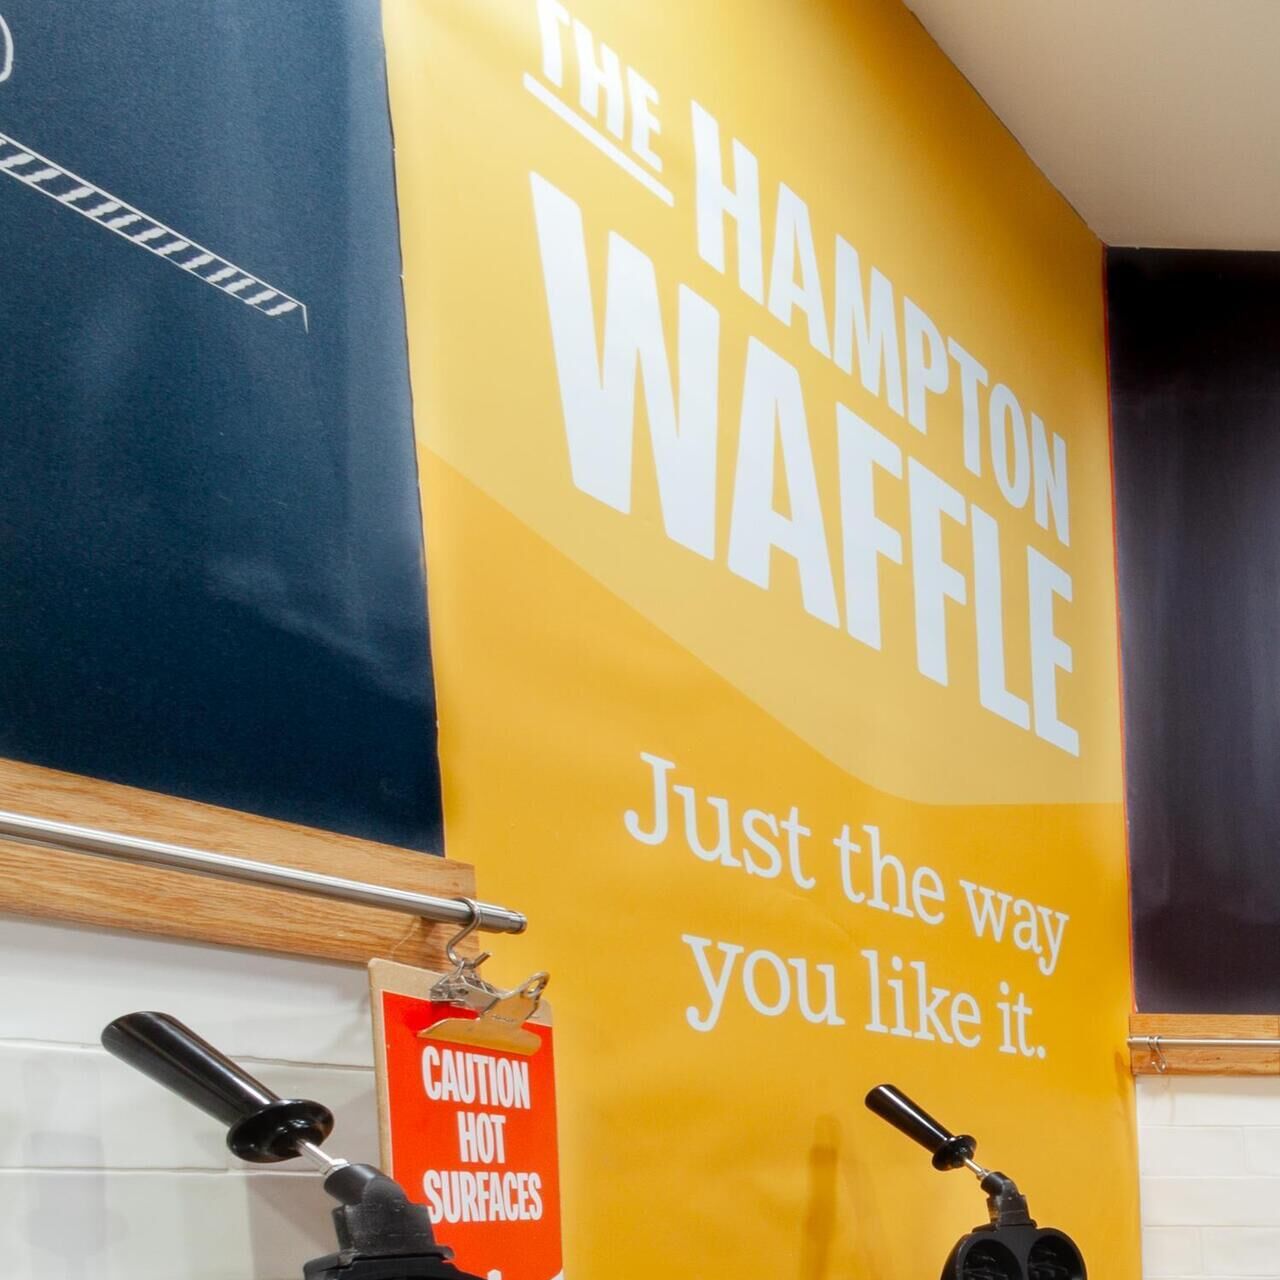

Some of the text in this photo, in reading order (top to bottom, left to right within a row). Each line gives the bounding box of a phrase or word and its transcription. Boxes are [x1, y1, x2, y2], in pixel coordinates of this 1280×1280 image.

[536, 0, 1069, 548] THE HAMPTON
[529, 171, 1079, 757] WAFFLE
[624, 750, 1069, 976] Just the way
[681, 933, 1046, 1060] you like it.
[422, 1044, 531, 1110] CAUTION
[457, 1111, 506, 1164] HOT
[422, 1169, 543, 1224] SURFACES
